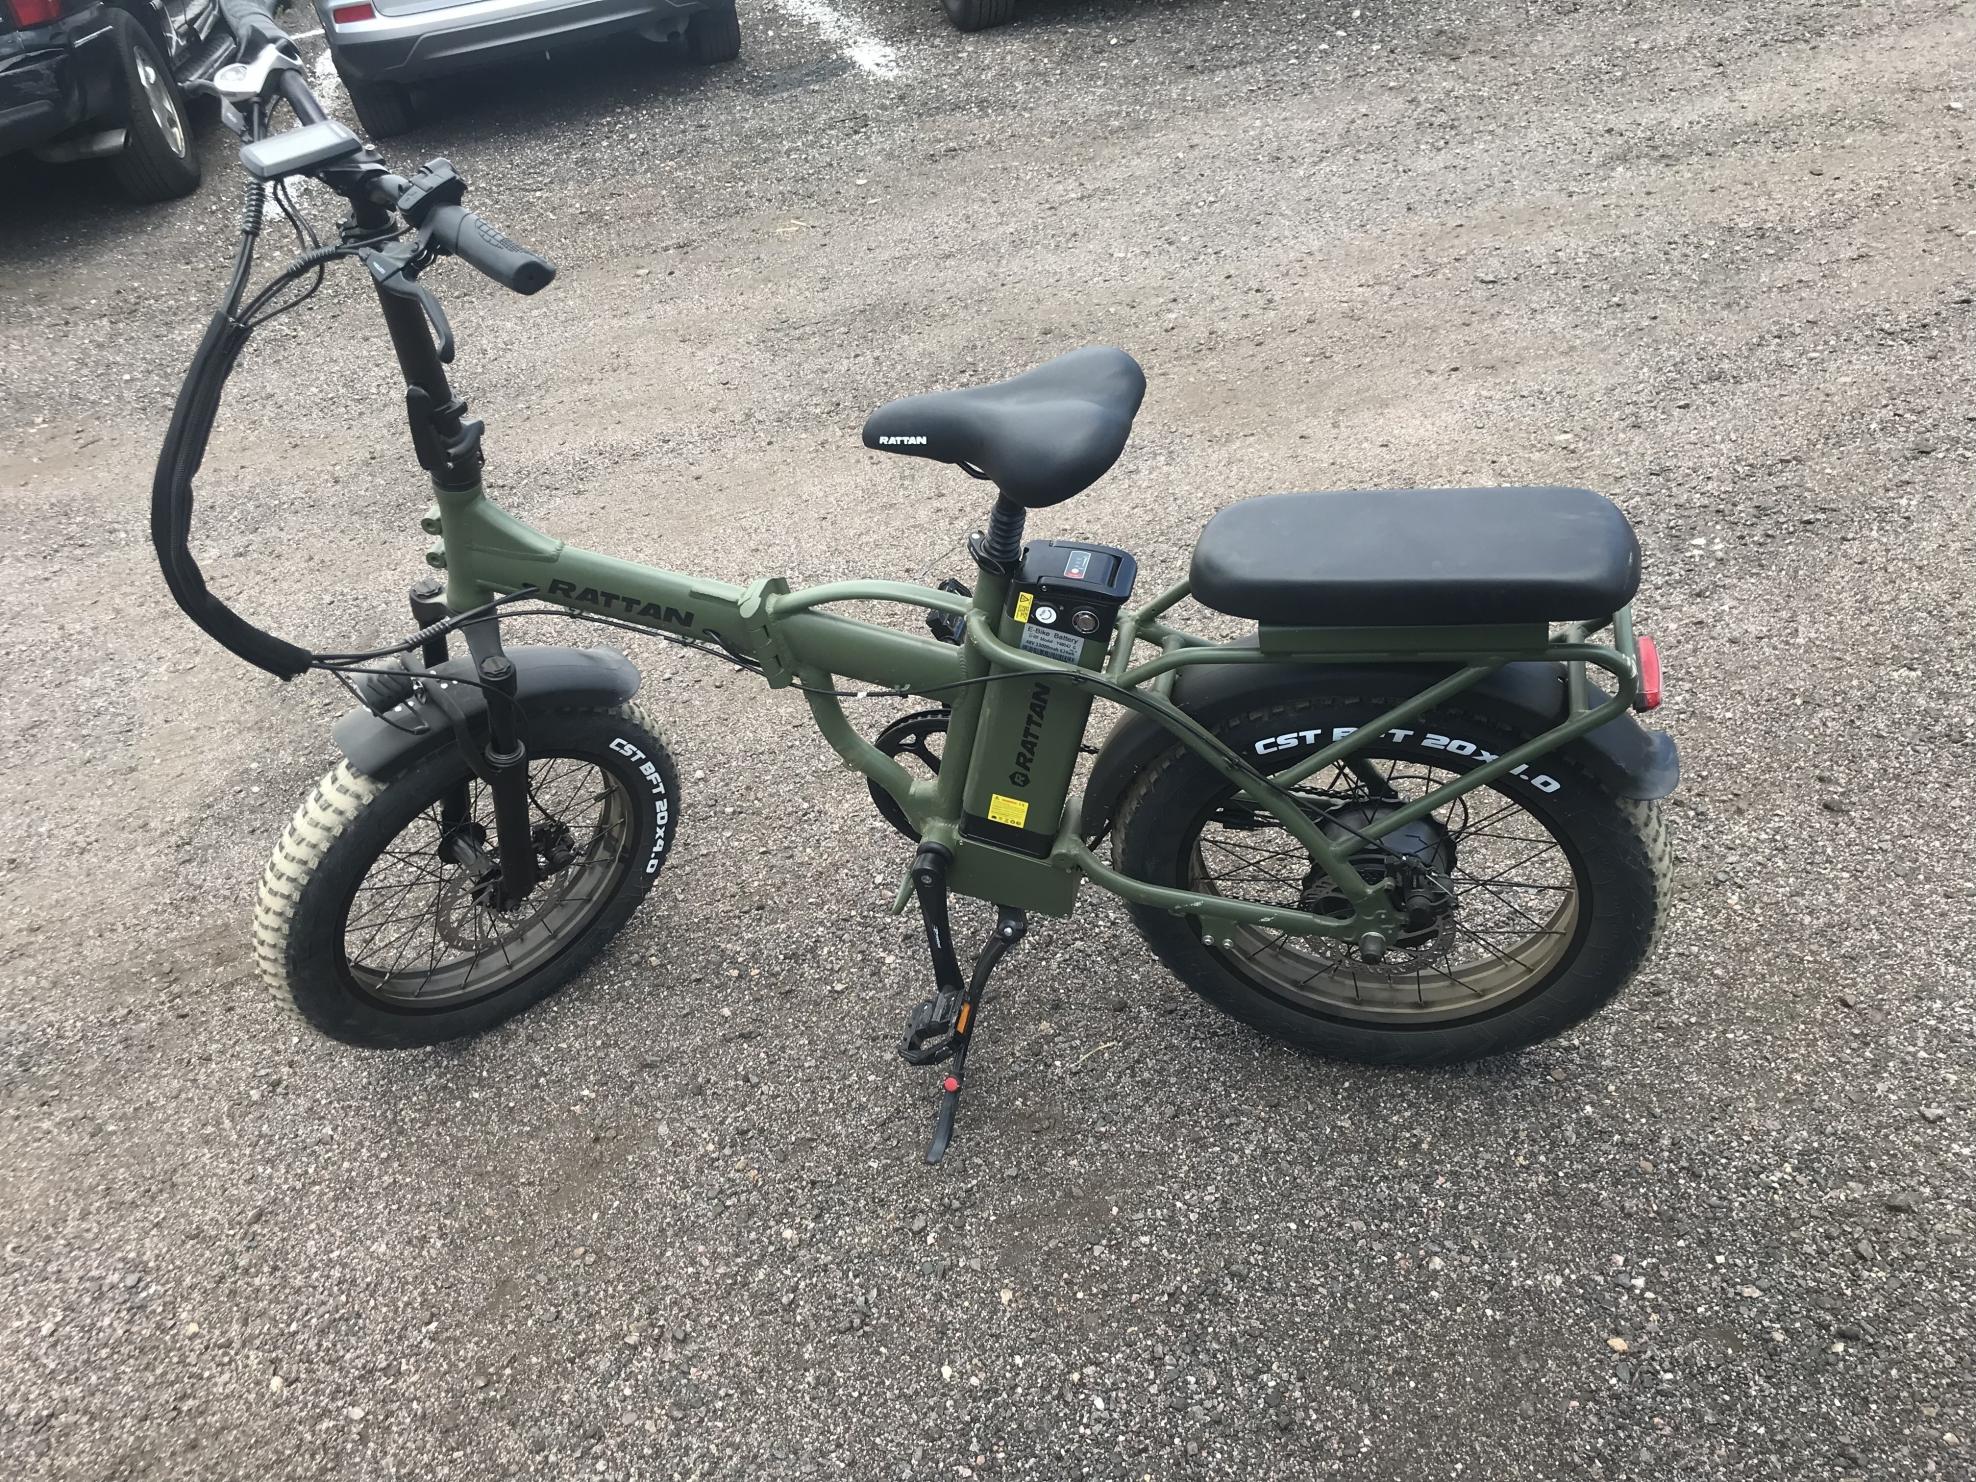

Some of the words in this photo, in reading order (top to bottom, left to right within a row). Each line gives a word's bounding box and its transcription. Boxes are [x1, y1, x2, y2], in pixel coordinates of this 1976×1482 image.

[879, 436, 927, 445] RATTAN
[548, 579, 695, 627] RATTAN
[1053, 632, 1078, 645] Battery
[1016, 682, 1050, 772] RATTAN
[1254, 728, 1322, 755] CST
[609, 737, 646, 762] CST
[639, 761, 666, 795] BFT
